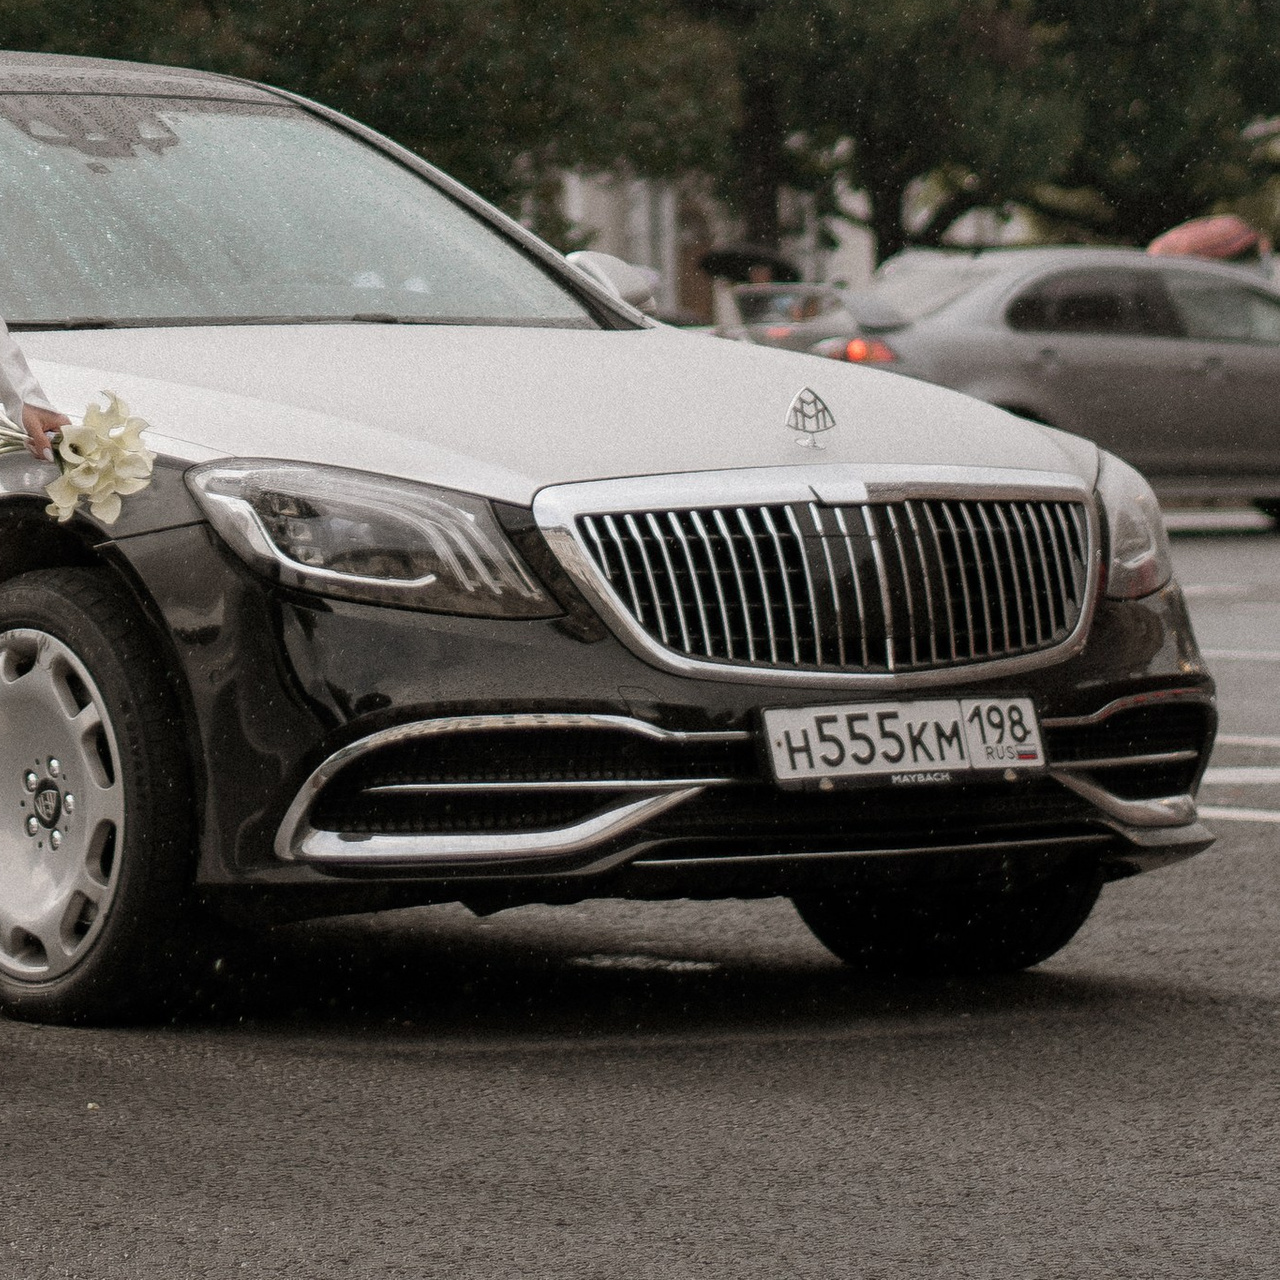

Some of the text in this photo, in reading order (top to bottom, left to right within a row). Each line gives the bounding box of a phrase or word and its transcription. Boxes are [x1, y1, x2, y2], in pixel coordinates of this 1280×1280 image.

[967, 704, 1031, 745] 198
[986, 745, 1016, 761] RUS
[891, 772, 951, 784] MAYBACH
